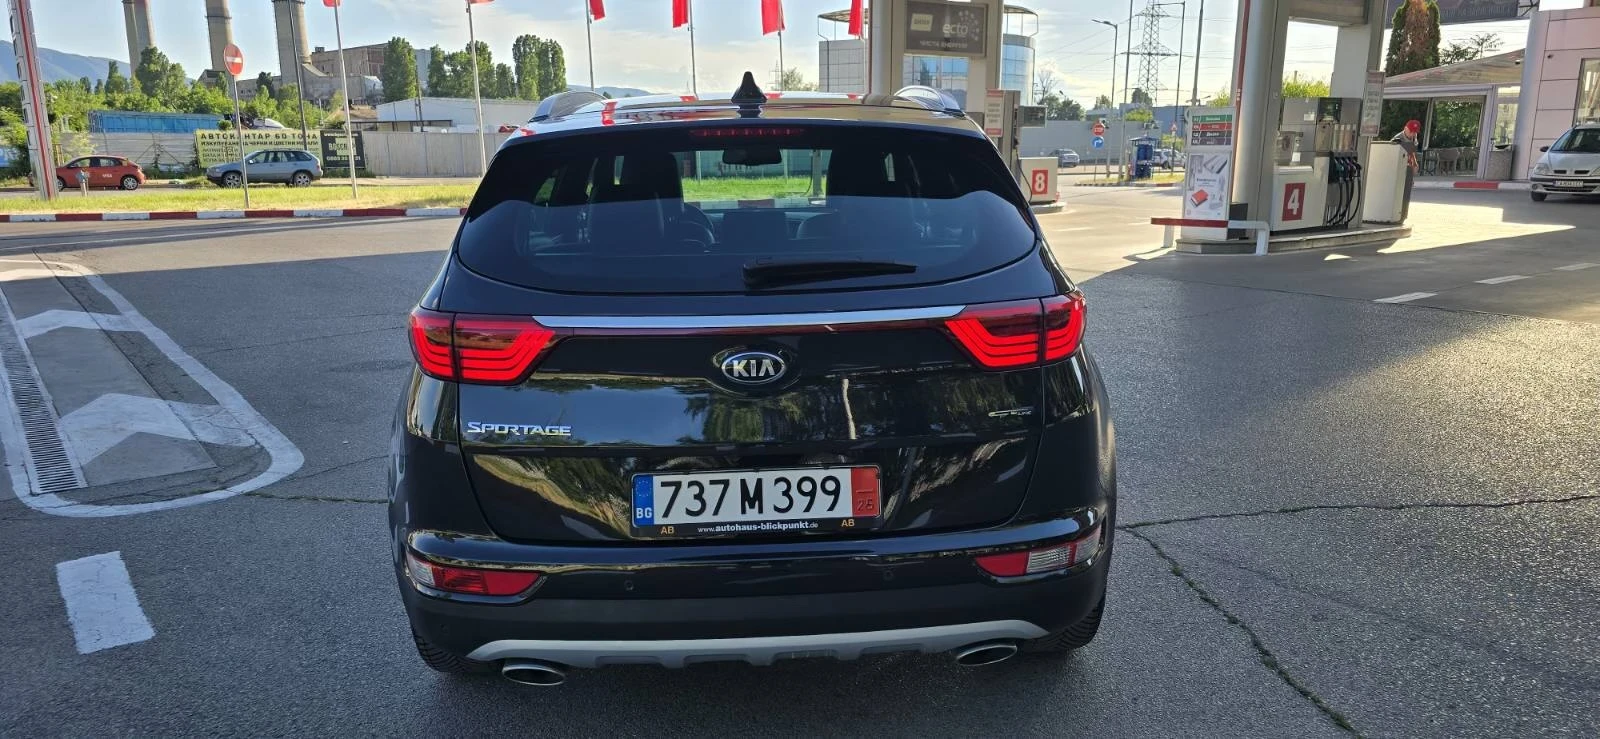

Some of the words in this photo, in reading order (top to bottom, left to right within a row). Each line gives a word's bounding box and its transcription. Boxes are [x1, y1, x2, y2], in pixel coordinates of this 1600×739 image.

[1034, 172, 1046, 192] 8
[1287, 188, 1300, 215] 4
[733, 359, 775, 377] KIA
[636, 507, 653, 518] BG
[660, 480, 730, 518] 737
[740, 477, 764, 515] M
[773, 475, 841, 514] 399
[660, 526, 675, 534] AB
[698, 522, 818, 533] www.autohaus-blickpunkt.de
[841, 519, 855, 527] AB
